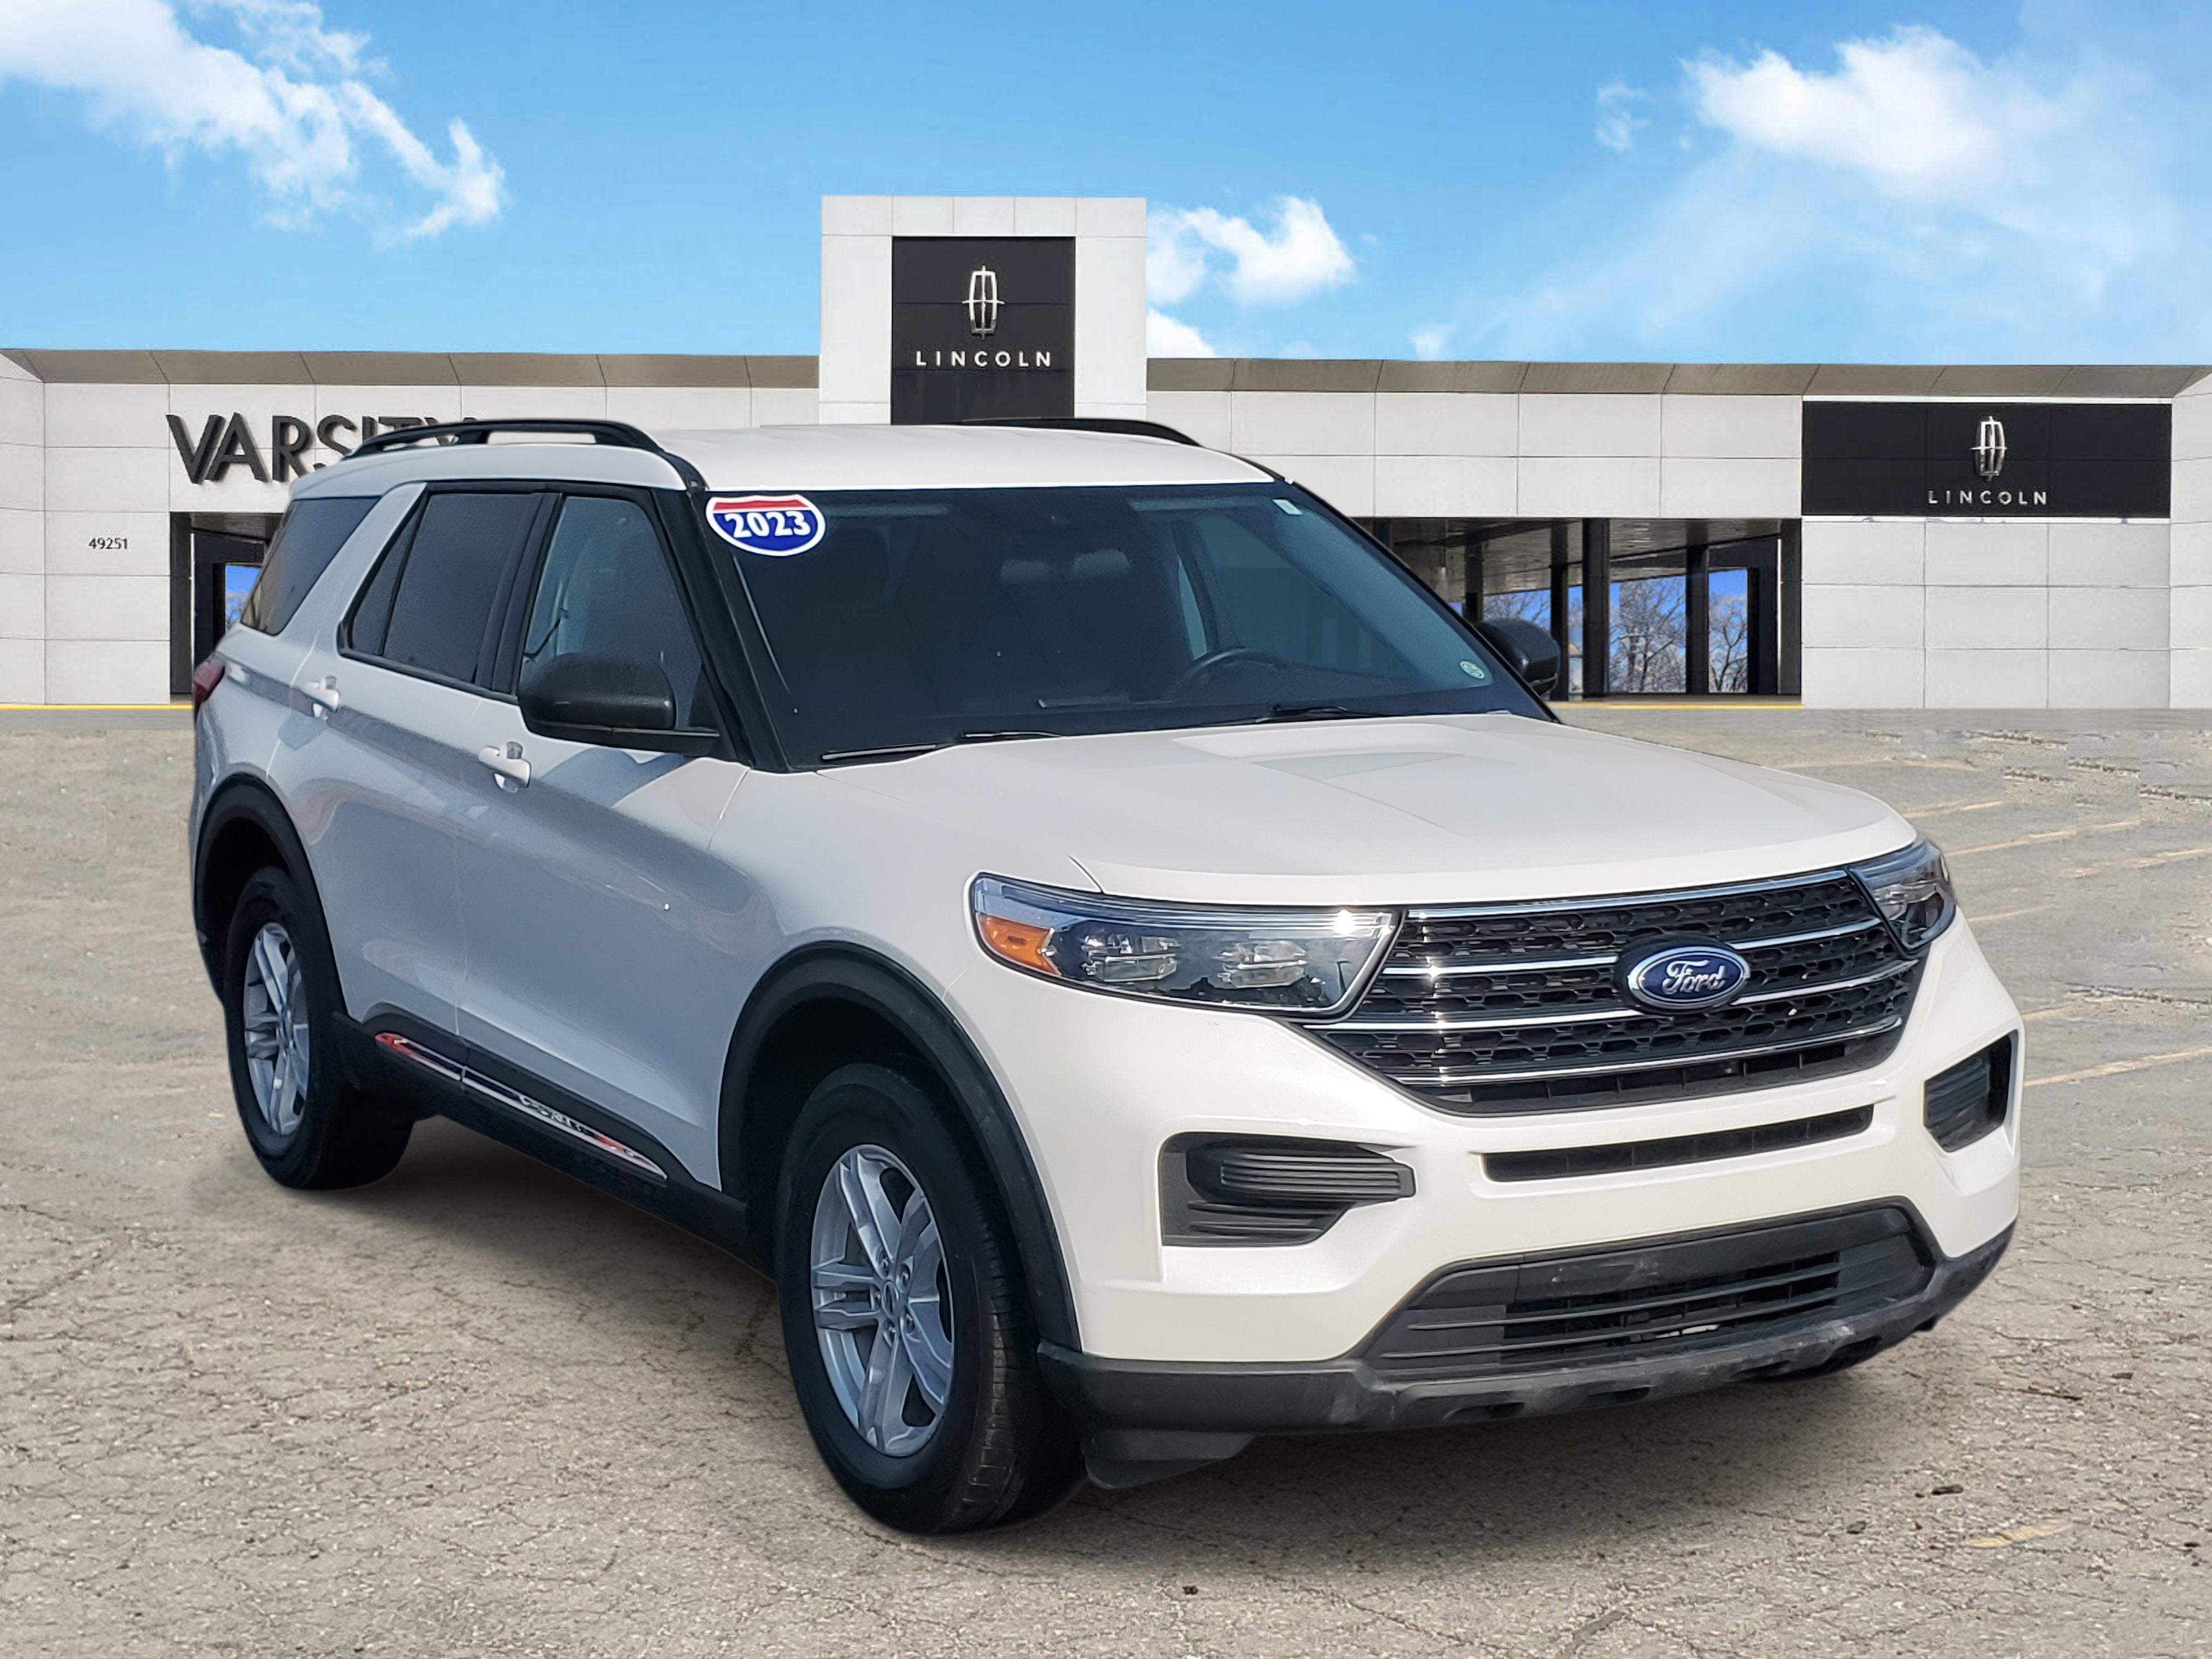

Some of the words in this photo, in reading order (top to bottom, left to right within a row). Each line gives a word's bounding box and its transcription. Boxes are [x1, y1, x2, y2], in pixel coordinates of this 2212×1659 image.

[915, 351, 1051, 367] LINCOLN
[166, 412, 477, 483] VARS
[1928, 490, 2048, 506] LINCOLN
[724, 511, 811, 538] 2023
[88, 537, 127, 549] 49251
[1662, 960, 1727, 995] Ford
